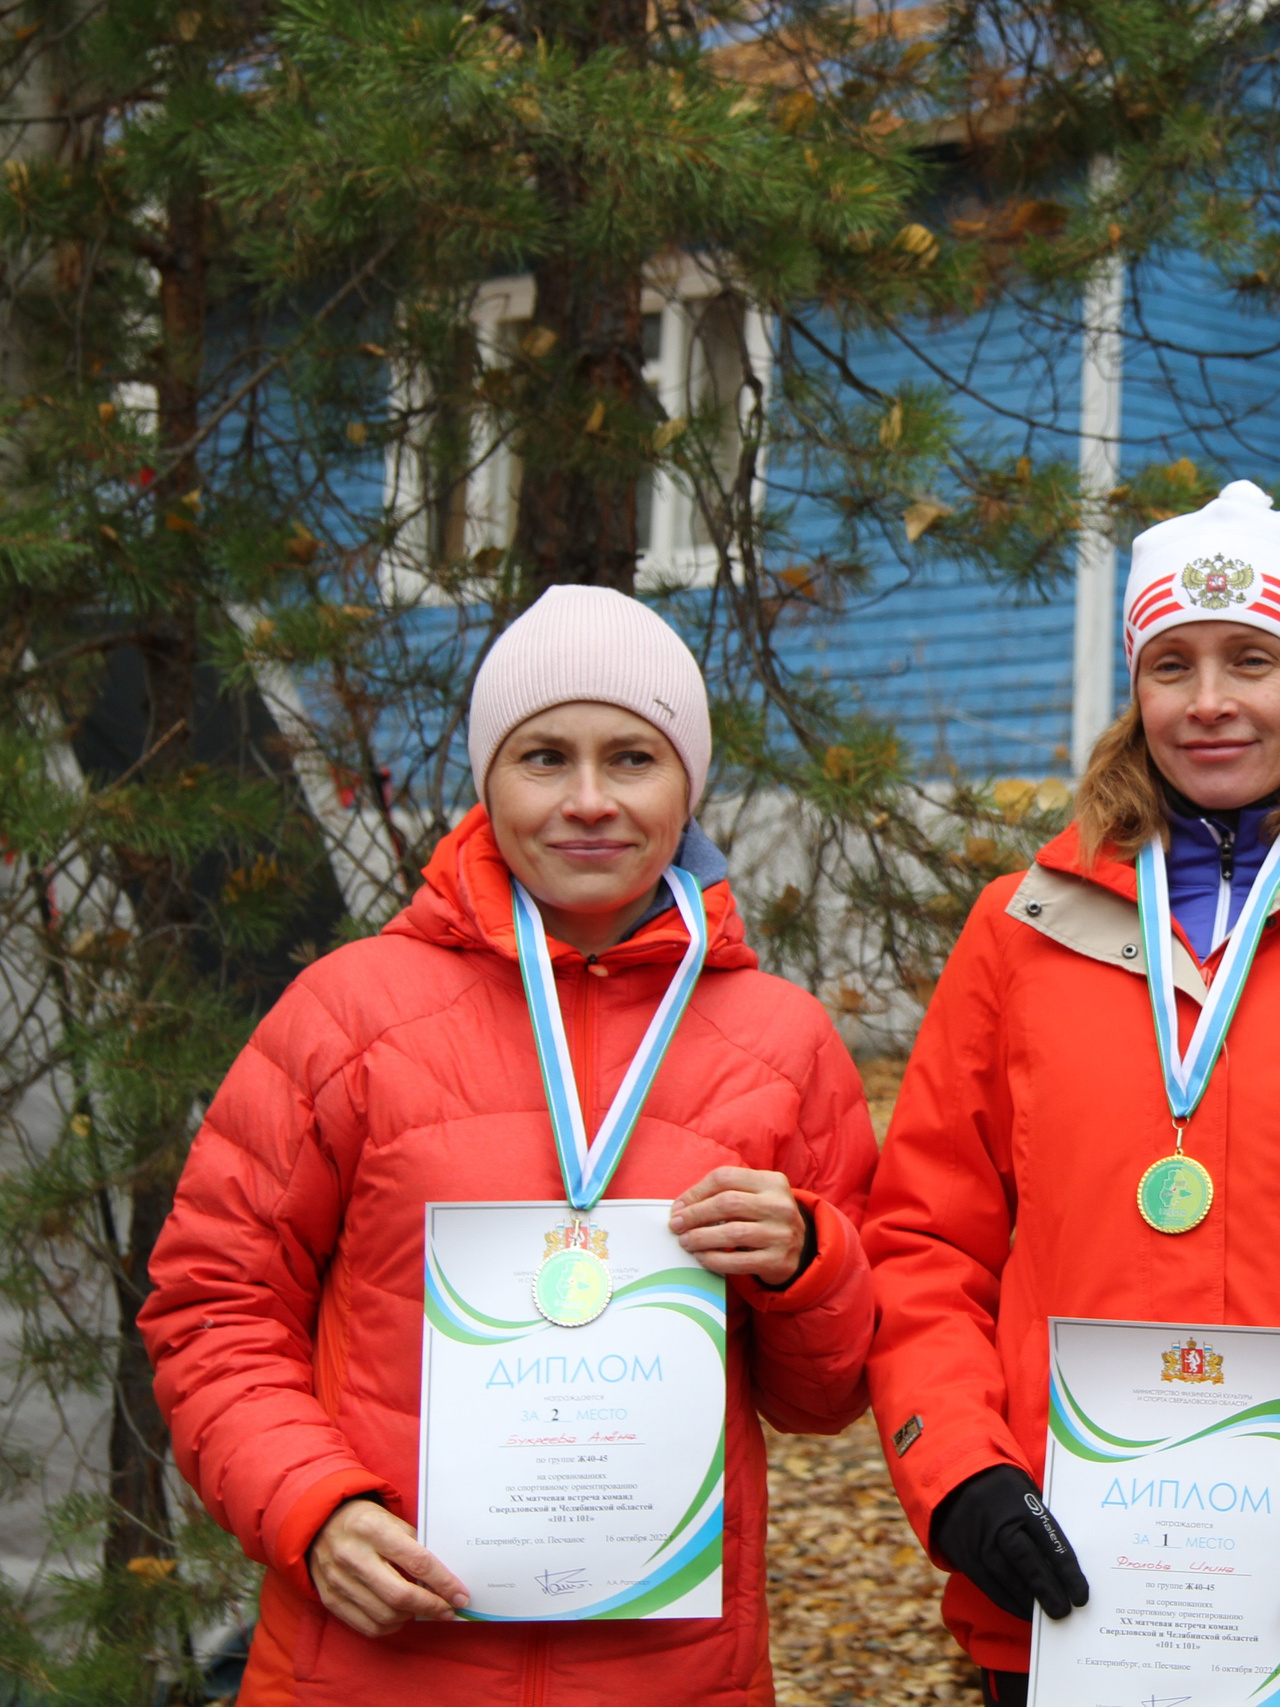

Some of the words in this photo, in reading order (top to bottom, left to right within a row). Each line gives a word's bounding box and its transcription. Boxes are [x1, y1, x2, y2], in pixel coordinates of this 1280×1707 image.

[485, 1354, 663, 1389] ДИПЛОМ
[544, 1394, 604, 1402] награждается
[1132, 1388, 1179, 1397] МИНИСТЕРСТВО
[1181, 1391, 1221, 1399] ФИЗИЧЕСКОЙ
[520, 1410, 540, 1422] ЗА
[551, 1408, 559, 1421] 2
[576, 1408, 628, 1421] МЕСТО
[548, 1457, 576, 1465] группе
[548, 1473, 607, 1482] соревнованиях
[517, 1484, 569, 1493] спортивному
[571, 1482, 638, 1492] ориентированию
[526, 1494, 565, 1502] матчевая
[567, 1494, 600, 1503] встреча
[602, 1493, 633, 1501] команд
[1101, 1477, 1271, 1514] ДИПЛОМ
[488, 1504, 549, 1515] Свердловской
[559, 1503, 614, 1513] Челябинской
[616, 1502, 653, 1511] областей
[1155, 1520, 1214, 1529] награждается
[548, 1535, 585, 1544] Песчаное
[605, 1535, 615, 1543] 16
[616, 1534, 647, 1544] октября
[1132, 1533, 1150, 1545] ЗА
[1163, 1533, 1168, 1546] 1
[1186, 1537, 1235, 1550] МЕСТО
[1157, 1582, 1183, 1591] группе
[1156, 1599, 1214, 1608] соревнованиях
[1126, 1608, 1176, 1618] спортивному
[1179, 1611, 1244, 1621] ориентированию
[1135, 1619, 1172, 1628] матчевая
[1174, 1622, 1206, 1631] встреча
[1099, 1626, 1157, 1637] Свердловской
[1166, 1630, 1220, 1641] Челябинской
[1222, 1634, 1259, 1642] областей
[1085, 1657, 1141, 1669] Екатеринбург,
[1154, 1661, 1191, 1671] Песчаное
[1211, 1664, 1220, 1672] 16
[1221, 1664, 1253, 1675] октября
[1254, 1666, 1273, 1675] 2022
